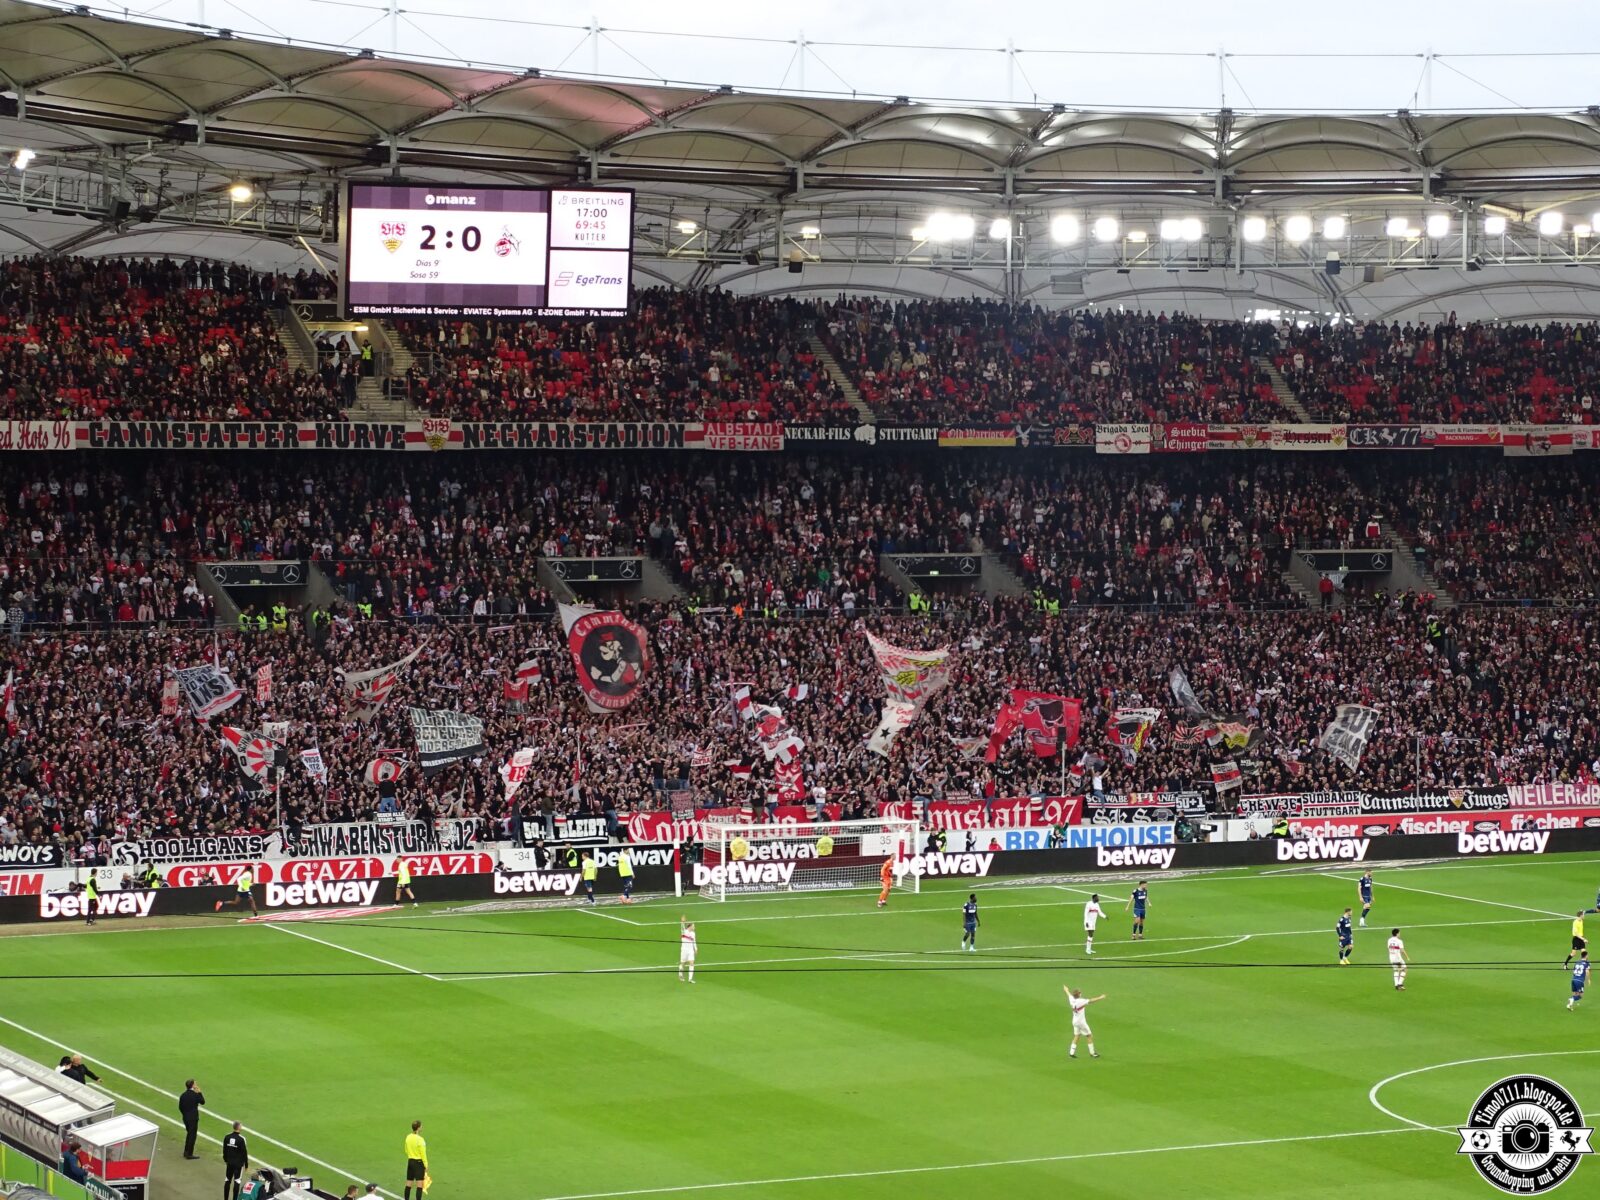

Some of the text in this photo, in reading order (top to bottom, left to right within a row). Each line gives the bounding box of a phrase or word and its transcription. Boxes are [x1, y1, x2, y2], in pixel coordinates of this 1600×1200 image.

[436, 195, 476, 205] manz
[571, 197, 625, 206] BREITLING
[576, 208, 608, 218] 17:00
[575, 220, 606, 230] 69:45
[415, 259, 433, 268] Dias
[410, 271, 427, 279] Sosa
[575, 275, 623, 287] EgeTrans
[353, 306, 370, 314] ESM
[392, 307, 426, 315] Sicherheit
[493, 309, 521, 317] Systems
[53, 420, 71, 450] 96
[88, 422, 406, 450] CANNSTATTER KURVE
[462, 422, 685, 450] NECKARSTADION
[706, 423, 783, 436] ALBSTADT
[783, 427, 939, 441] NECKAR-FILS STUTTGART
[1096, 424, 1149, 434] Brigada Loca
[1170, 426, 1206, 438] Suebia
[710, 437, 782, 449] VFB-FANS
[1462, 789, 1510, 811] Jungs
[881, 800, 1033, 830] Cnnstatt
[1303, 805, 1361, 817] STUTTGART
[1401, 817, 1469, 835] fischer
[139, 834, 263, 860] HOOLIGANS
[1458, 830, 1551, 855] betway
[1276, 838, 1371, 862] betway
[892, 852, 995, 877] betway
[1097, 846, 1176, 869] betway
[292, 858, 375, 883] GAZI
[408, 855, 484, 877] GAZI
[693, 860, 797, 886] betway
[99, 869, 114, 880] 33
[494, 871, 582, 897] betway
[265, 879, 380, 908] betway
[1573, 964, 1585, 975] 23
